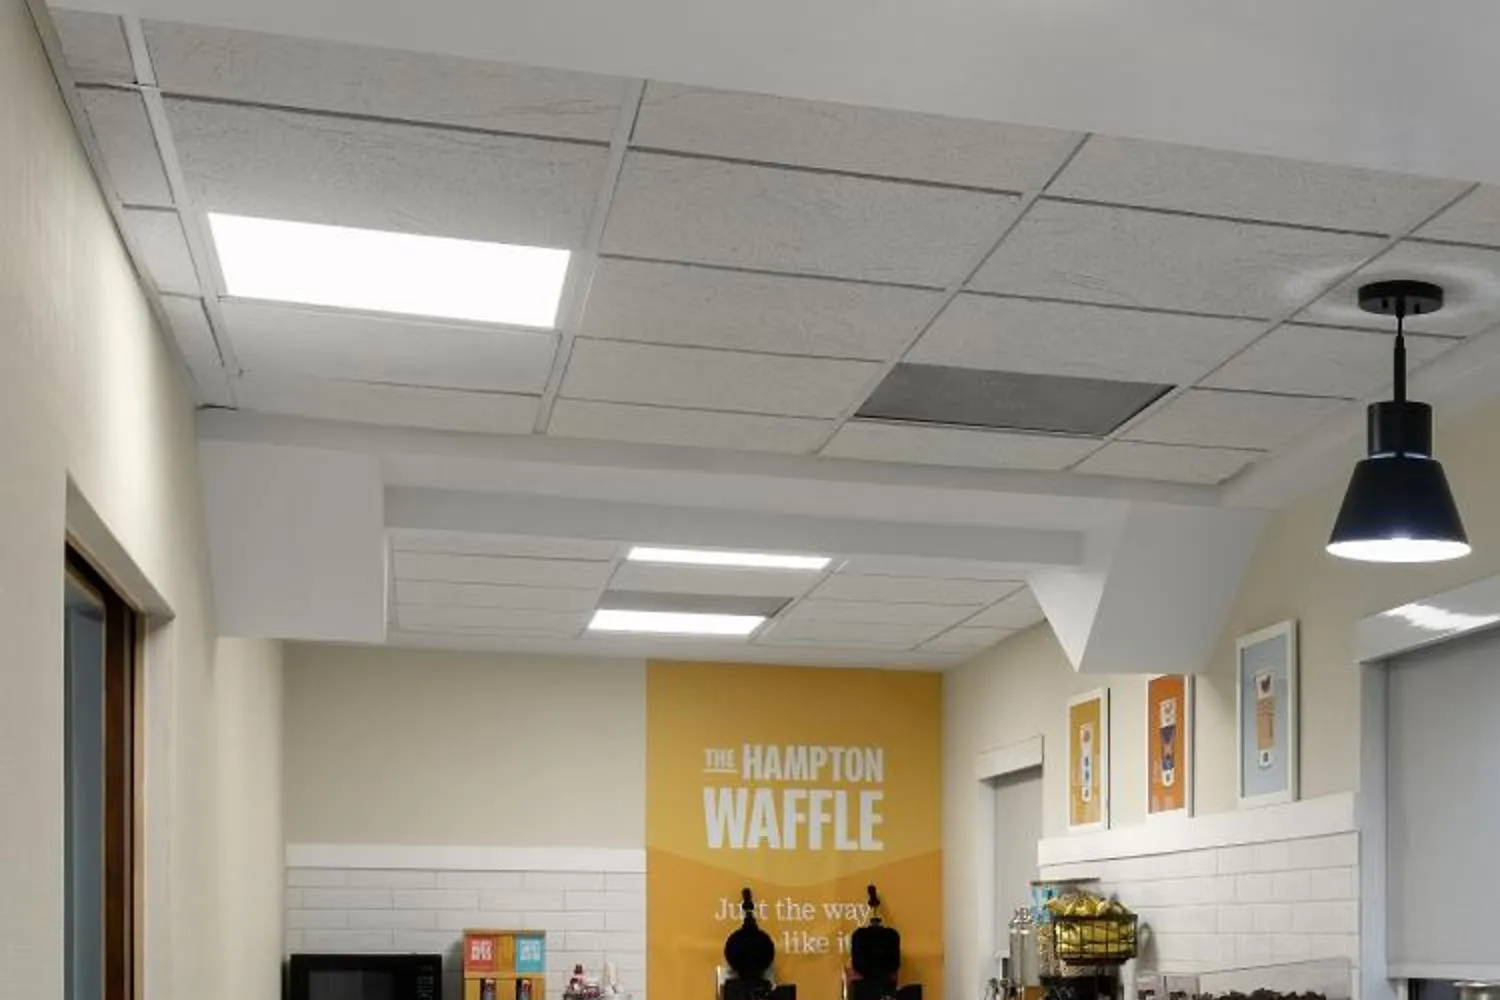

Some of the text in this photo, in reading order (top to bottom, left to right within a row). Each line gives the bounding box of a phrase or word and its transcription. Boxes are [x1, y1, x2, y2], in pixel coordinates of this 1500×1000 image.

[704, 743, 884, 783] THE HAMPTON
[703, 785, 885, 851] WAFFLE
[714, 897, 872, 928] Jut the way
[783, 930, 829, 955] like
